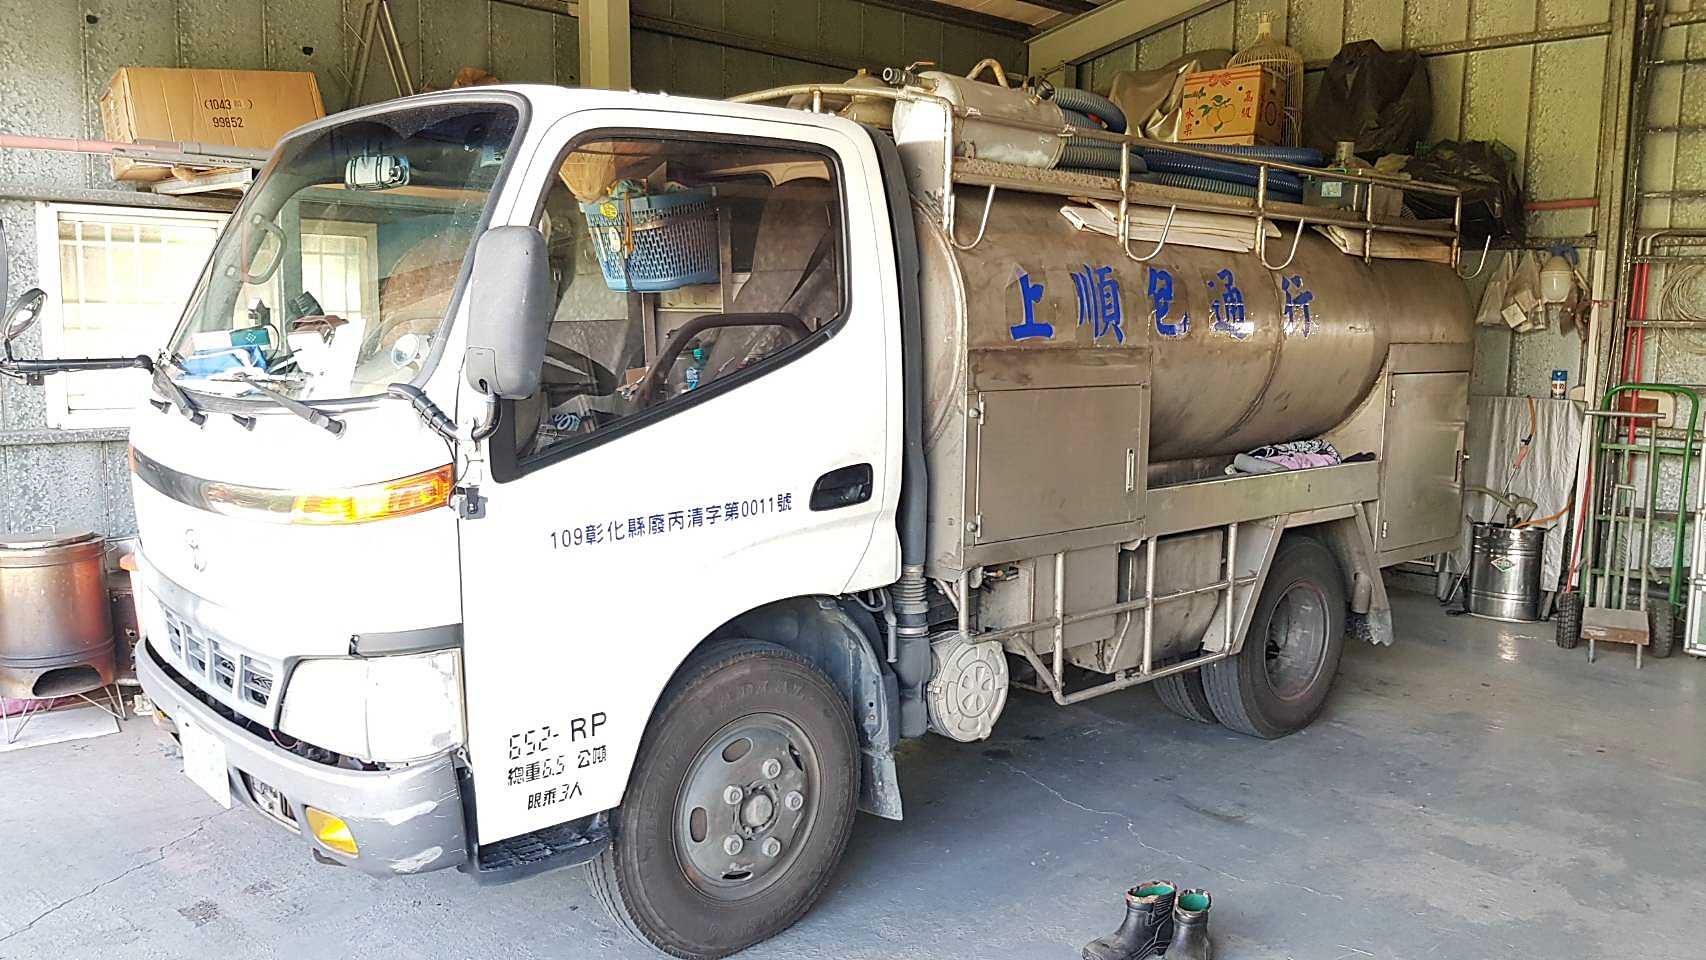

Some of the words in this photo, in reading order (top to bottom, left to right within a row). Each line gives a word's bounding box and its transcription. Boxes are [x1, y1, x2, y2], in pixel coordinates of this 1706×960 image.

[212, 116, 244, 128] 99852
[550, 492, 792, 550] 109彰化縣廢丙清字第0011號
[571, 711, 607, 742] RP
